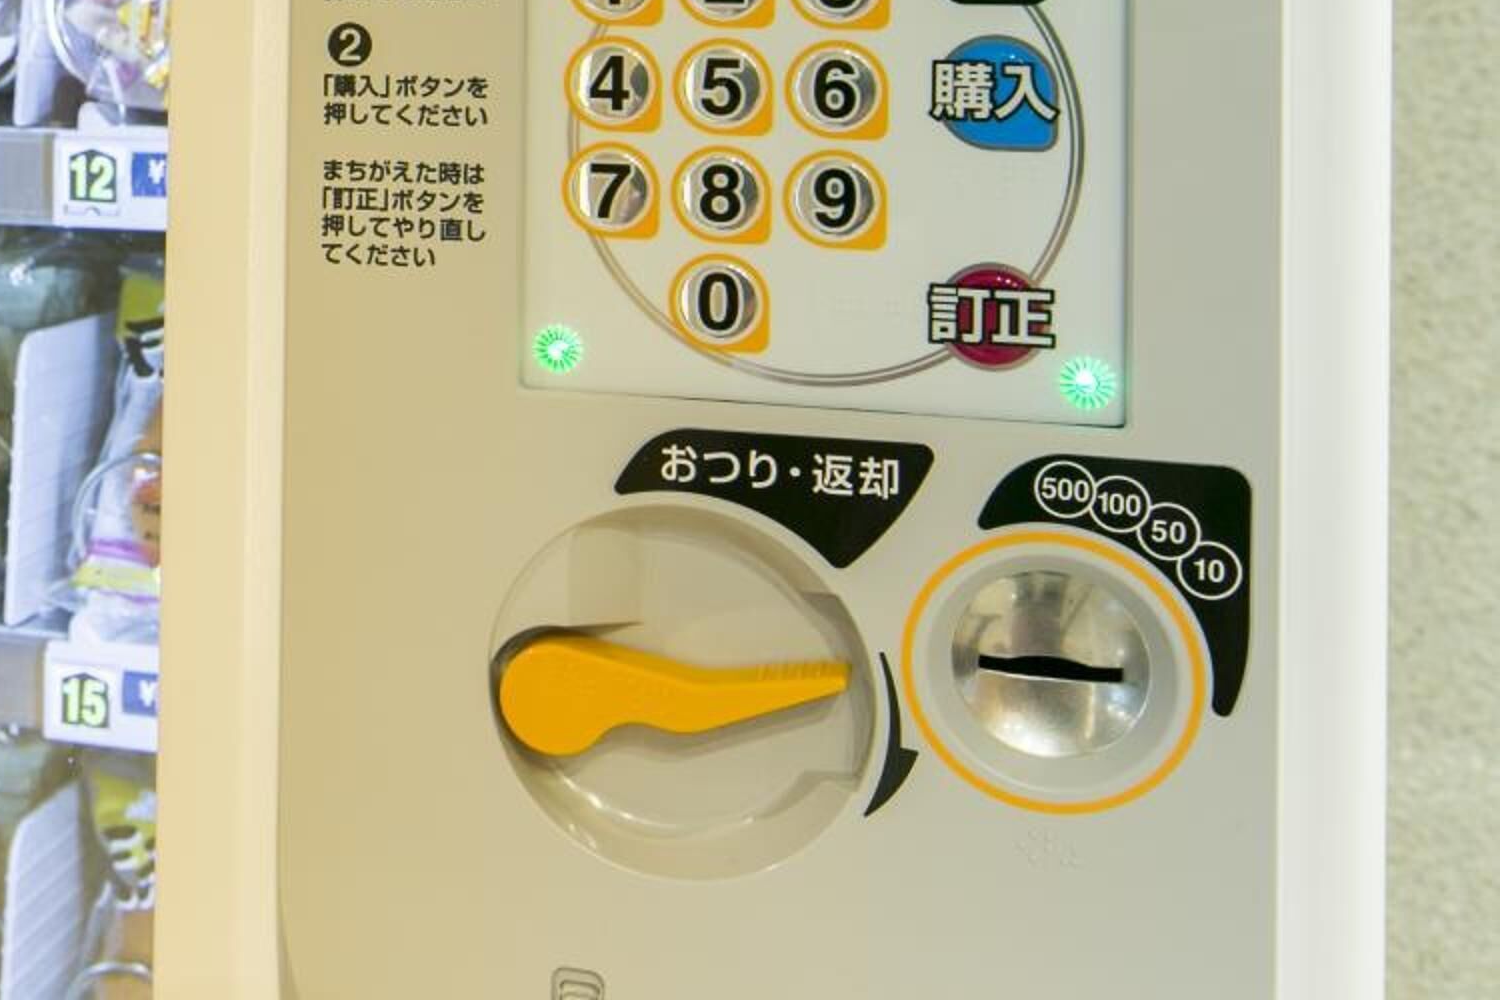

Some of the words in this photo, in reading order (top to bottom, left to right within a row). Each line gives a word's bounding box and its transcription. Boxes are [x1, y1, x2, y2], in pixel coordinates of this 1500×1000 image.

[324, 74, 489, 99] 「購入」ボタンを
[589, 55, 630, 111] 4
[700, 58, 742, 116] 5
[813, 60, 856, 119] 6
[929, 60, 1060, 123] 購入
[324, 103, 488, 127] 押してください
[69, 153, 116, 199] 12
[323, 160, 485, 185] まちがえた時は
[589, 163, 632, 219] 7
[699, 164, 742, 223] 8
[322, 186, 484, 214] 「訂正」ボタンを
[813, 168, 857, 228] 9
[321, 214, 486, 242] 押してやり直し
[321, 243, 436, 268] てください
[698, 272, 739, 331] 0
[927, 283, 1056, 349] 訂正
[660, 444, 900, 500] おつり・返却
[1041, 477, 1090, 503] 500
[1098, 491, 1141, 518] 100
[1151, 520, 1187, 545] 50
[1194, 559, 1225, 583] 10
[63, 677, 108, 727] 15
